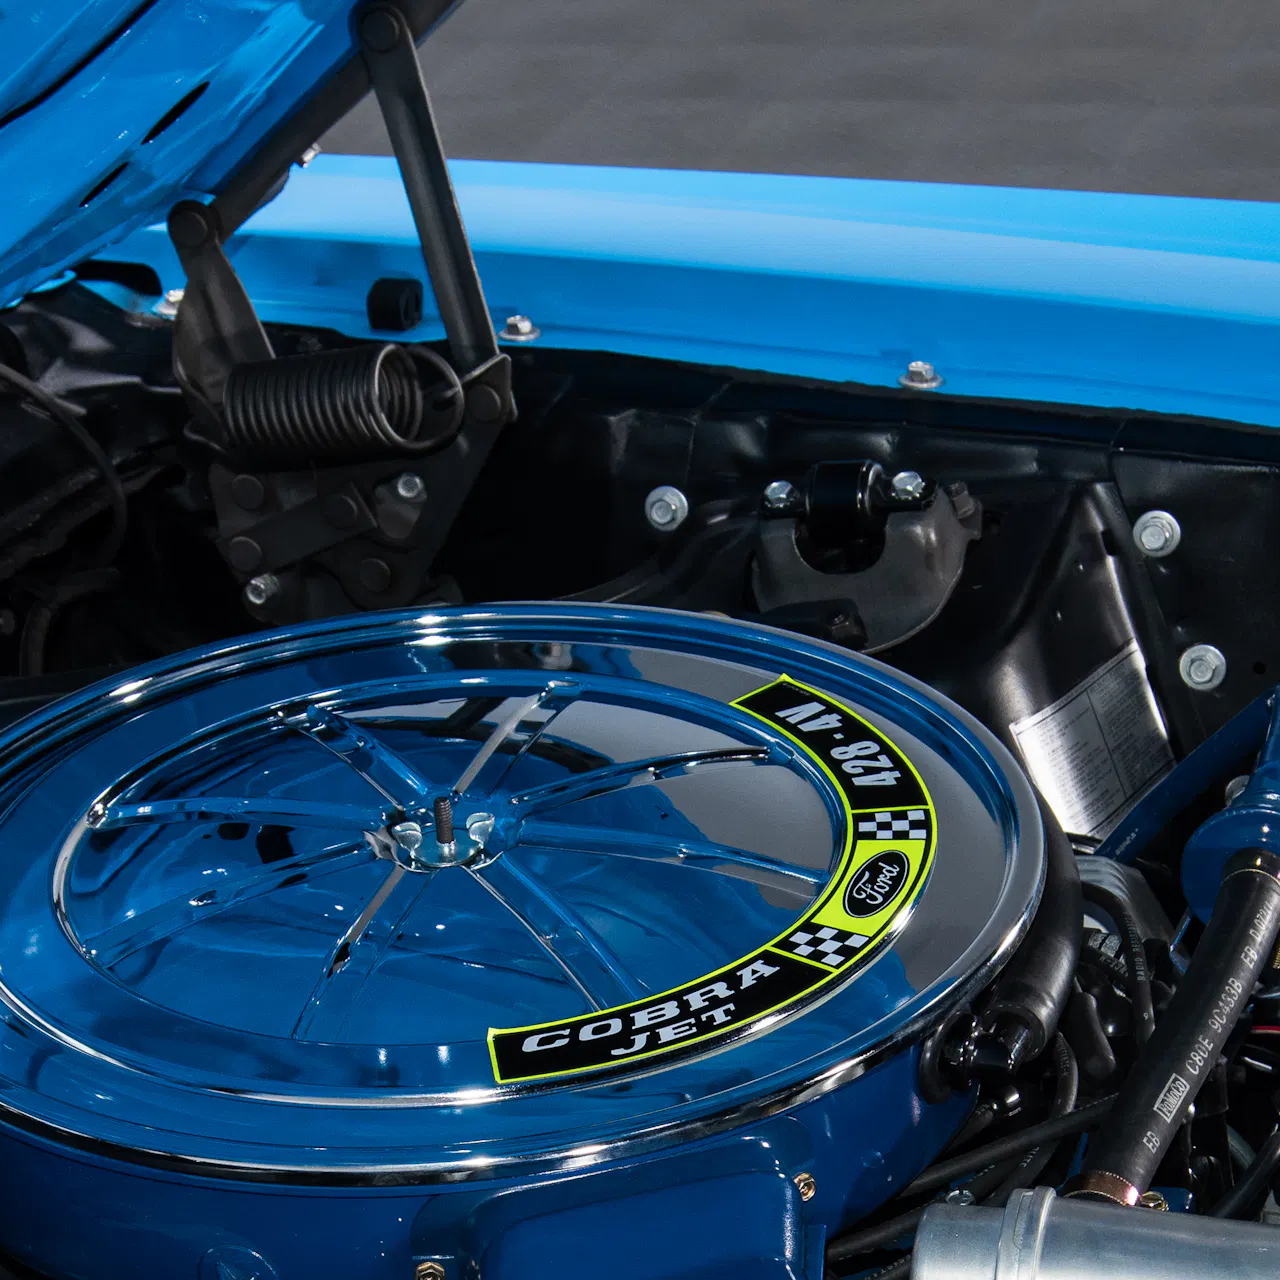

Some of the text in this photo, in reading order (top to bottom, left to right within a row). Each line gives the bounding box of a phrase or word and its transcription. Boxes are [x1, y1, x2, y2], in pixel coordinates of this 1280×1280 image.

[851, 863, 900, 905] Ford
[521, 959, 781, 1053] COBRA
[611, 1003, 735, 1055] JET
[1143, 1131, 1161, 1154] EB
[1240, 946, 1258, 969] EB
